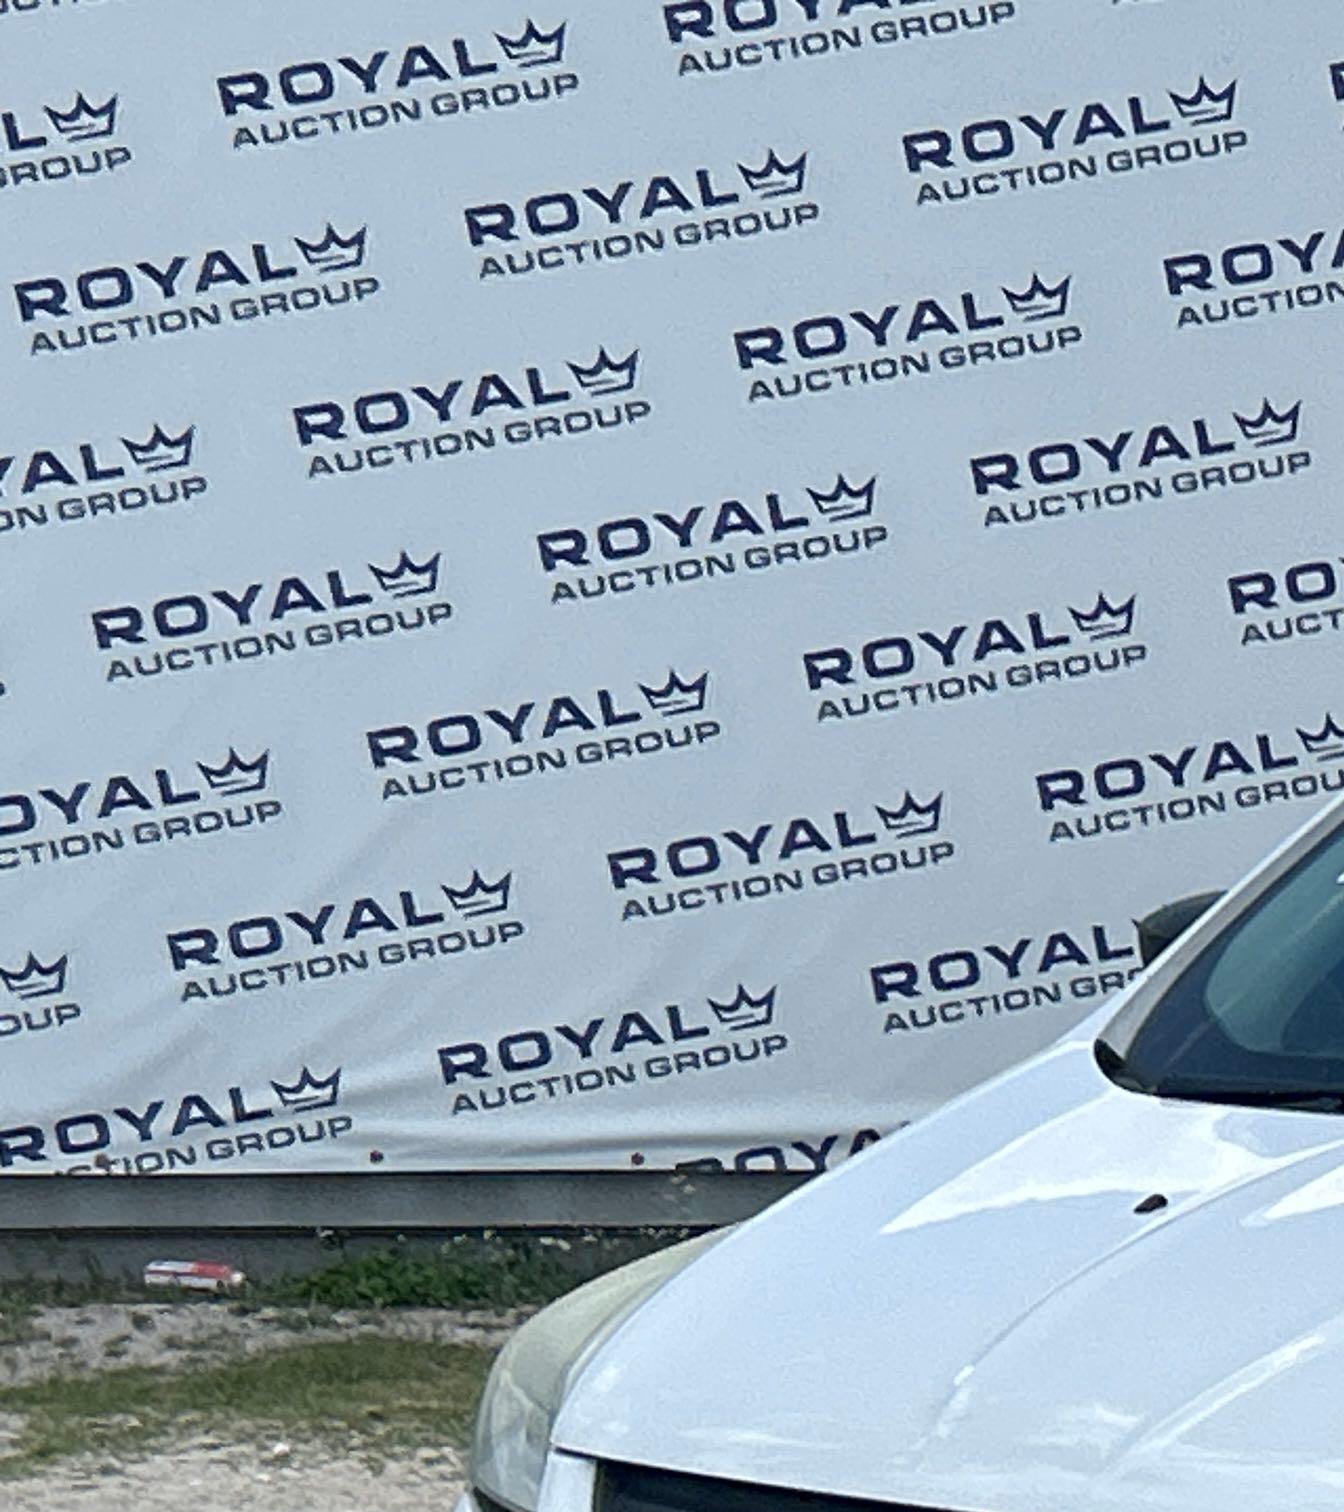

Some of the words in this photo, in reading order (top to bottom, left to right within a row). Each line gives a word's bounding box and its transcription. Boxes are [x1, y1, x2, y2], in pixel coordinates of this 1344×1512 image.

[217, 38, 499, 117] ROYAL
[679, 26, 862, 76] AUCTION
[871, 2, 1015, 44] GROUP
[233, 98, 422, 149] AUCTION
[429, 73, 579, 116] GROUP
[902, 97, 1172, 173] ROYAL
[917, 155, 1097, 206] AUCTION
[1106, 131, 1247, 173] GROUP
[464, 169, 739, 247] ROYAL
[480, 228, 665, 279] AUCTION
[673, 202, 819, 245] GROUP
[12, 244, 299, 322] ROYAL
[31, 303, 221, 355] AUCTION
[229, 278, 379, 320] GROUP
[733, 292, 1004, 370] ROYAL
[749, 351, 930, 402] AUCTION
[938, 326, 1082, 369] GROUP
[292, 368, 572, 446] ROYAL
[309, 427, 495, 478] AUCTION
[503, 401, 651, 444] GROUP
[970, 419, 1236, 495] ROYAL
[985, 477, 1162, 527] AUCTION
[1171, 452, 1311, 494] GROUP
[56, 476, 207, 521] GROUP
[536, 493, 810, 572] ROYAL
[551, 553, 735, 604] AUCTION
[744, 526, 887, 569] GROUP
[91, 570, 373, 650] ROYAL
[107, 630, 296, 682] AUCTION
[304, 603, 452, 646] GROUP
[803, 612, 1071, 691] ROYAL
[818, 671, 998, 722] AUCTION
[1006, 645, 1147, 687] GROUP
[366, 689, 642, 769] ROYAL
[383, 748, 567, 800] AUCTION
[575, 721, 720, 764] GROUP
[1035, 734, 1299, 811] ROYAL
[132, 801, 282, 844] GROUP
[607, 812, 878, 890] ROYAL
[1050, 791, 1226, 842] AUCTION
[622, 869, 804, 921] AUCTION
[812, 842, 954, 886] GROUP
[166, 890, 445, 971] ROYAL
[181, 950, 368, 1003] AUCTION
[378, 921, 524, 965] GROUP
[870, 925, 1134, 1004] ROYAL
[437, 1005, 710, 1088] ROYAL
[884, 982, 1062, 1033] AUCTION
[452, 1062, 636, 1116] AUCTION
[644, 1035, 787, 1079] GROUP
[205, 1116, 352, 1160] GROUP
